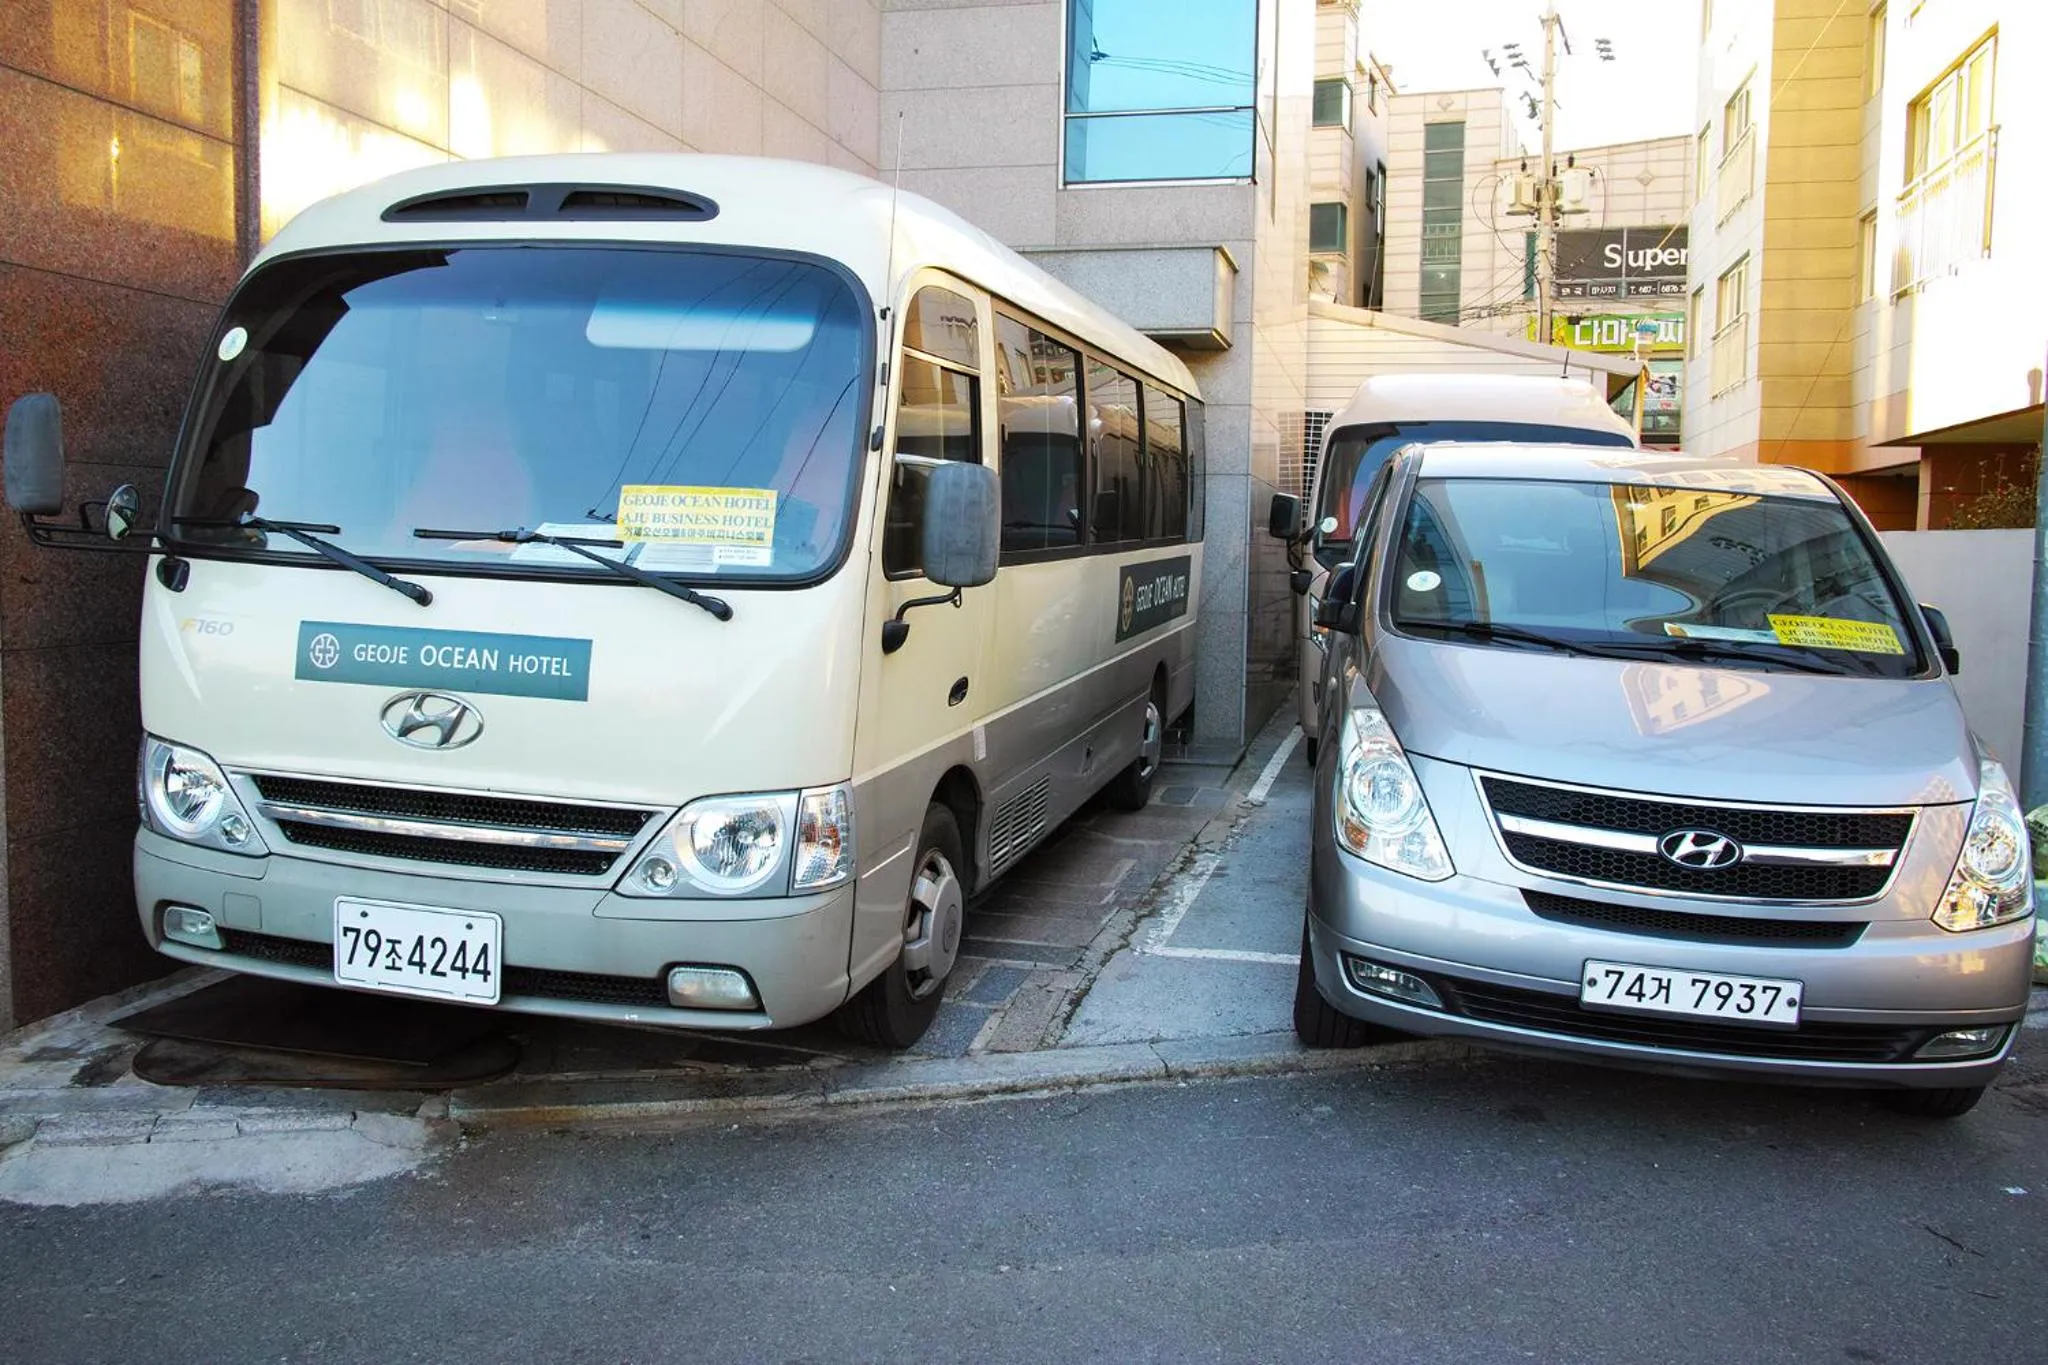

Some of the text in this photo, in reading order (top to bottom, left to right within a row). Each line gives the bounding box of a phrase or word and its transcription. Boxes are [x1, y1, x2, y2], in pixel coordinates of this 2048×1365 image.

[1604, 244, 1687, 271] Super
[624, 494, 772, 510] GEOJE OCEAN HOTEL
[623, 511, 772, 529] AJU BUSINESS HOTEL
[353, 643, 572, 677] GEOJE OCEAN HOTEL
[342, 926, 492, 983] 79조4244
[1604, 969, 1782, 1016] 74거 7937
